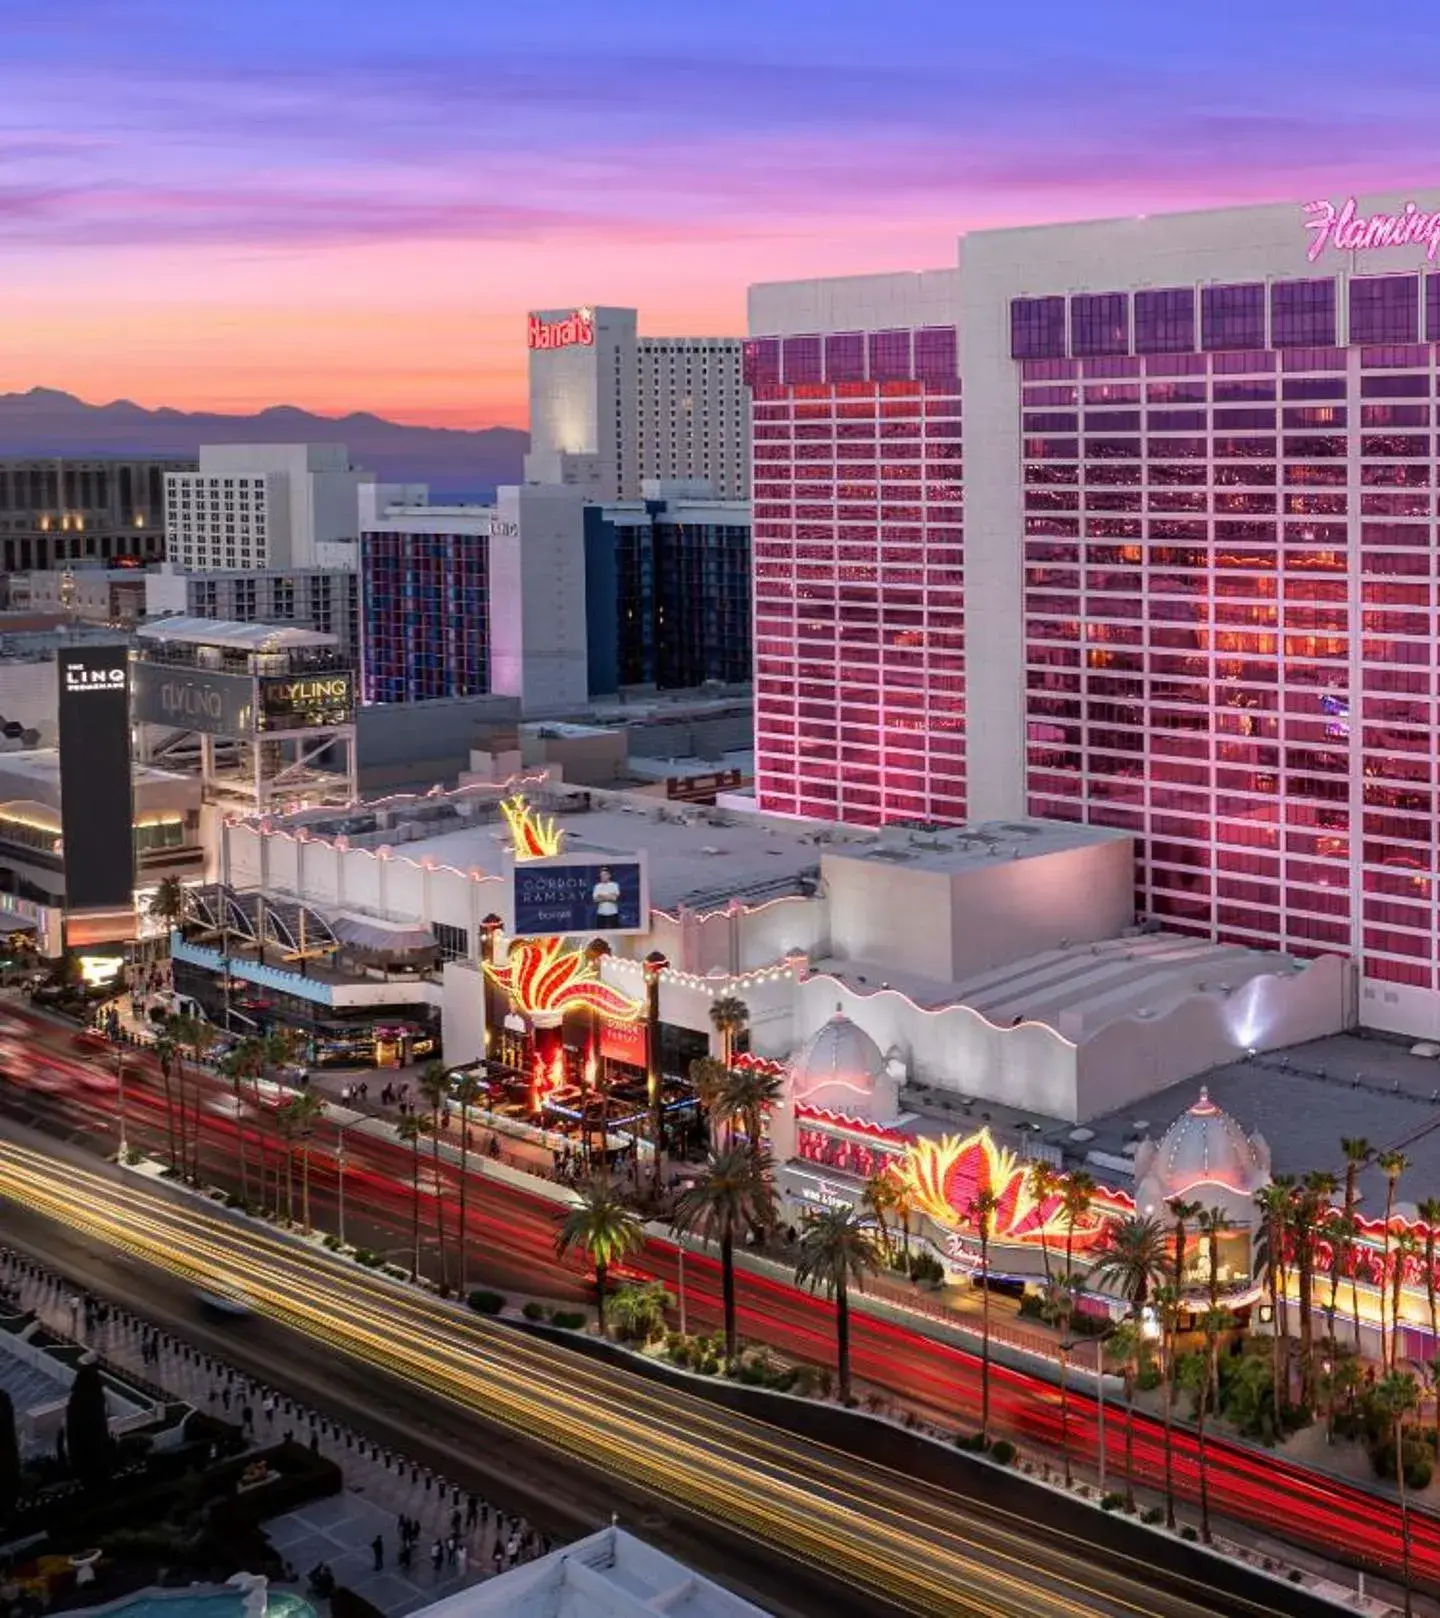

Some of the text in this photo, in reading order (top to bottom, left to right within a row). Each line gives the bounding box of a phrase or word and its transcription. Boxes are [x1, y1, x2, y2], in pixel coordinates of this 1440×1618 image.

[66, 669, 125, 684] LINQ
[523, 877, 588, 890] GORDON
[523, 891, 587, 902] RAMSAY
